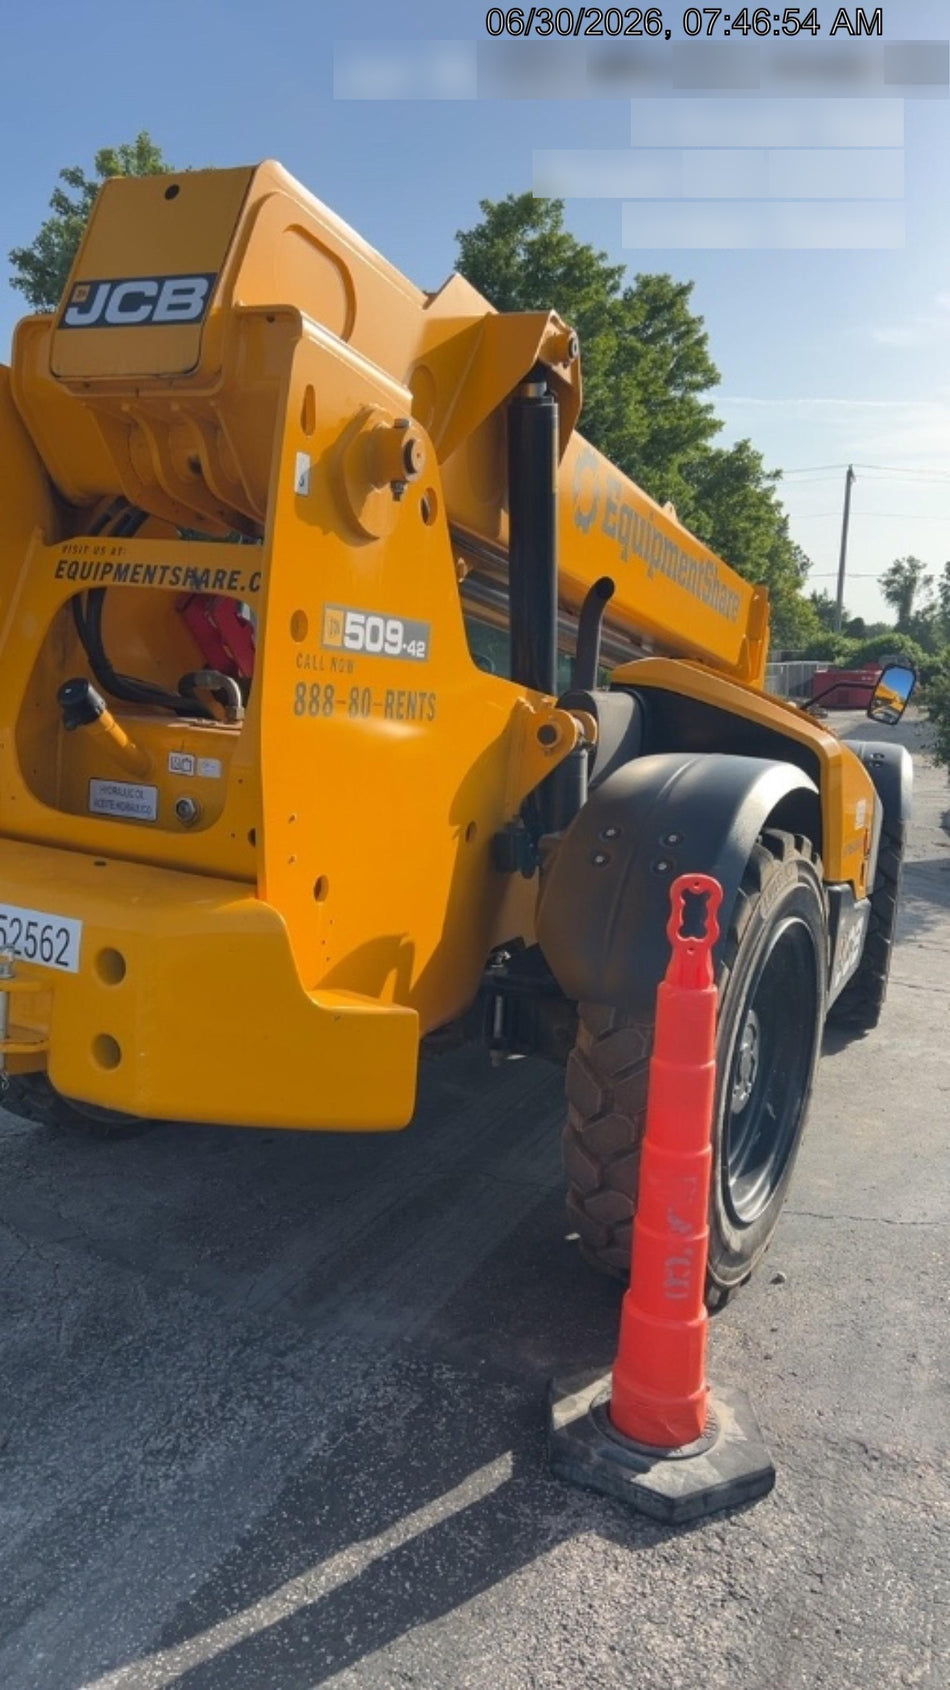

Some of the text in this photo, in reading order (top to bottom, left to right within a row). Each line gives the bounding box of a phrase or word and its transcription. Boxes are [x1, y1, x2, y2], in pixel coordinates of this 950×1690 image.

[64, 277, 209, 326] JCB
[296, 652, 354, 674] CALL NOW
[293, 681, 437, 722] 888-80-RENTS
